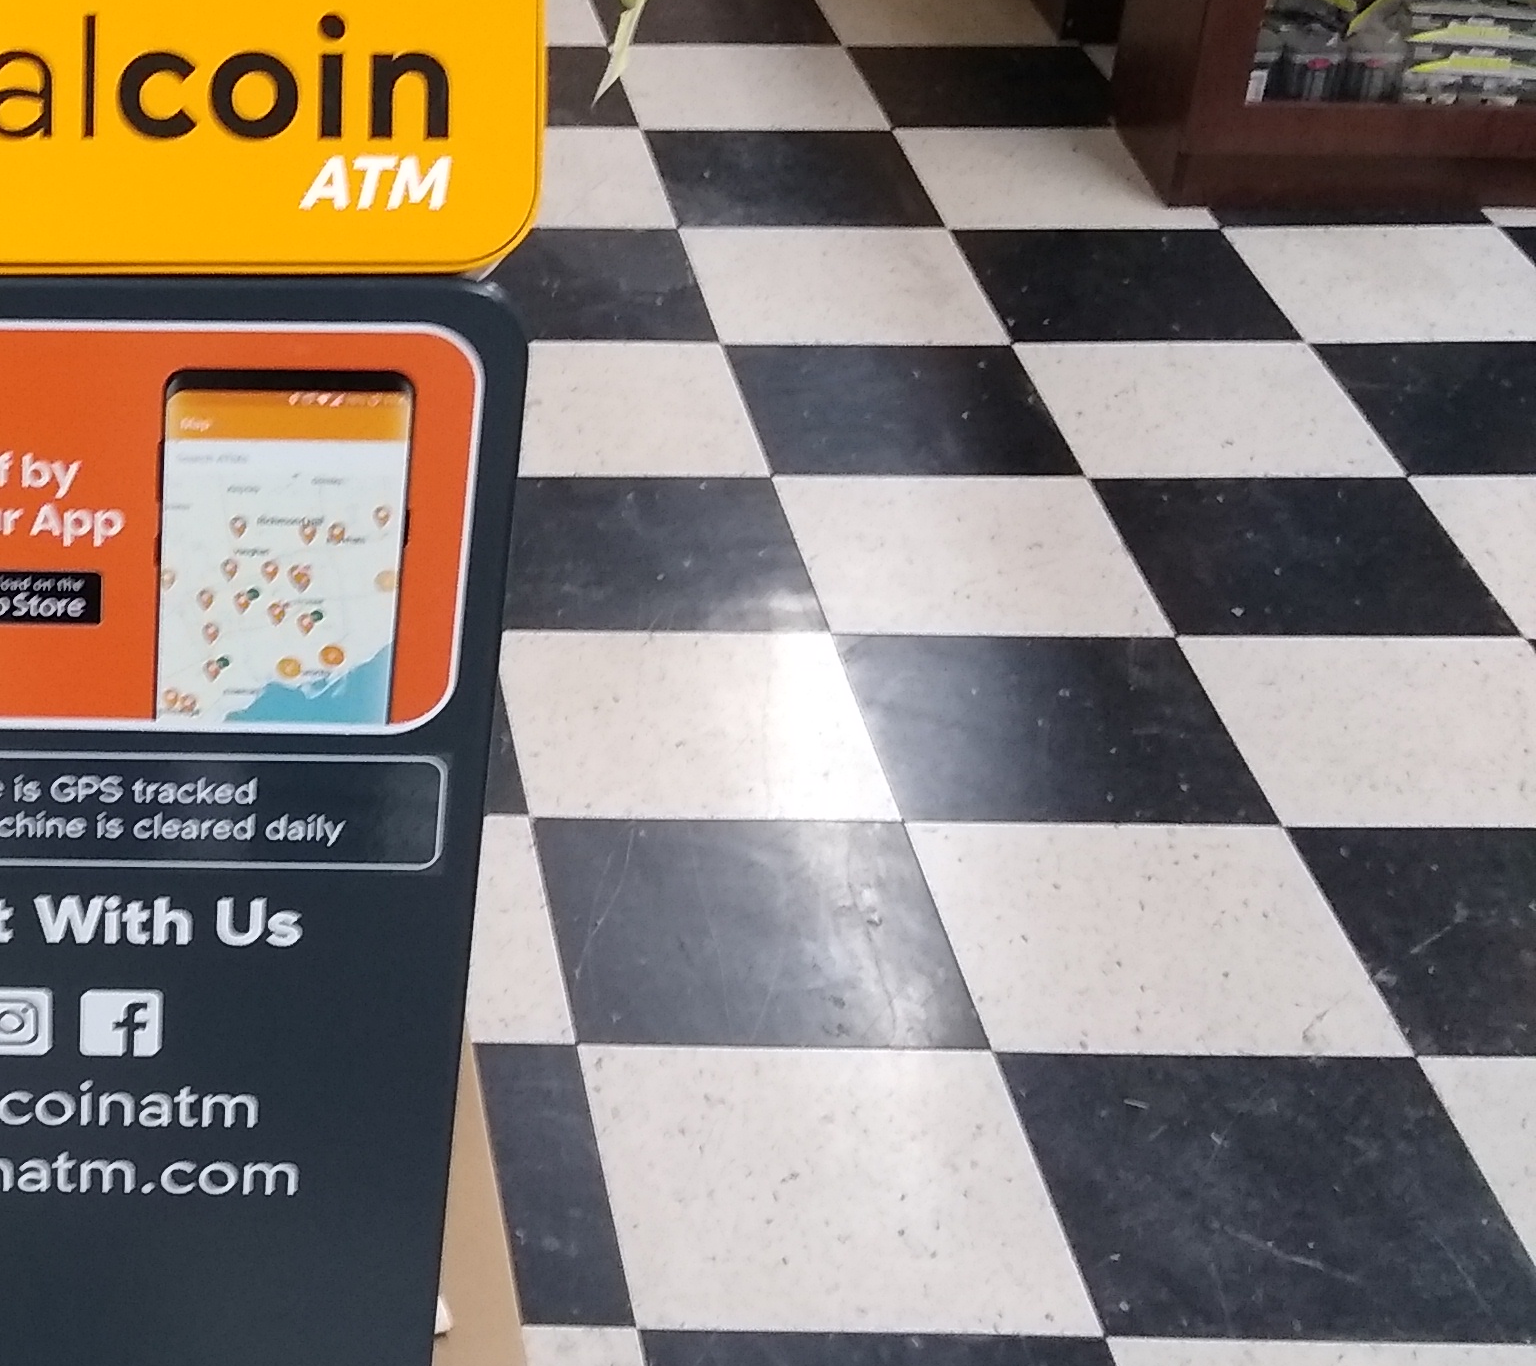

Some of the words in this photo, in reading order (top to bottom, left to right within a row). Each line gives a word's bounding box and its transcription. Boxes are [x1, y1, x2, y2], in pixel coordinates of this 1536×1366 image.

[299, 154, 454, 212] ATM
[22, 452, 83, 498] by
[29, 502, 126, 547] App
[34, 577, 53, 592] on
[54, 575, 85, 593] the
[12, 592, 87, 619] Store
[11, 775, 42, 804] is
[49, 775, 125, 806] GPS
[130, 777, 259, 807] tracked
[94, 811, 126, 841] is
[131, 811, 257, 842] cleared
[262, 813, 347, 848] daily
[31, 893, 195, 949] With
[214, 897, 305, 949] Us
